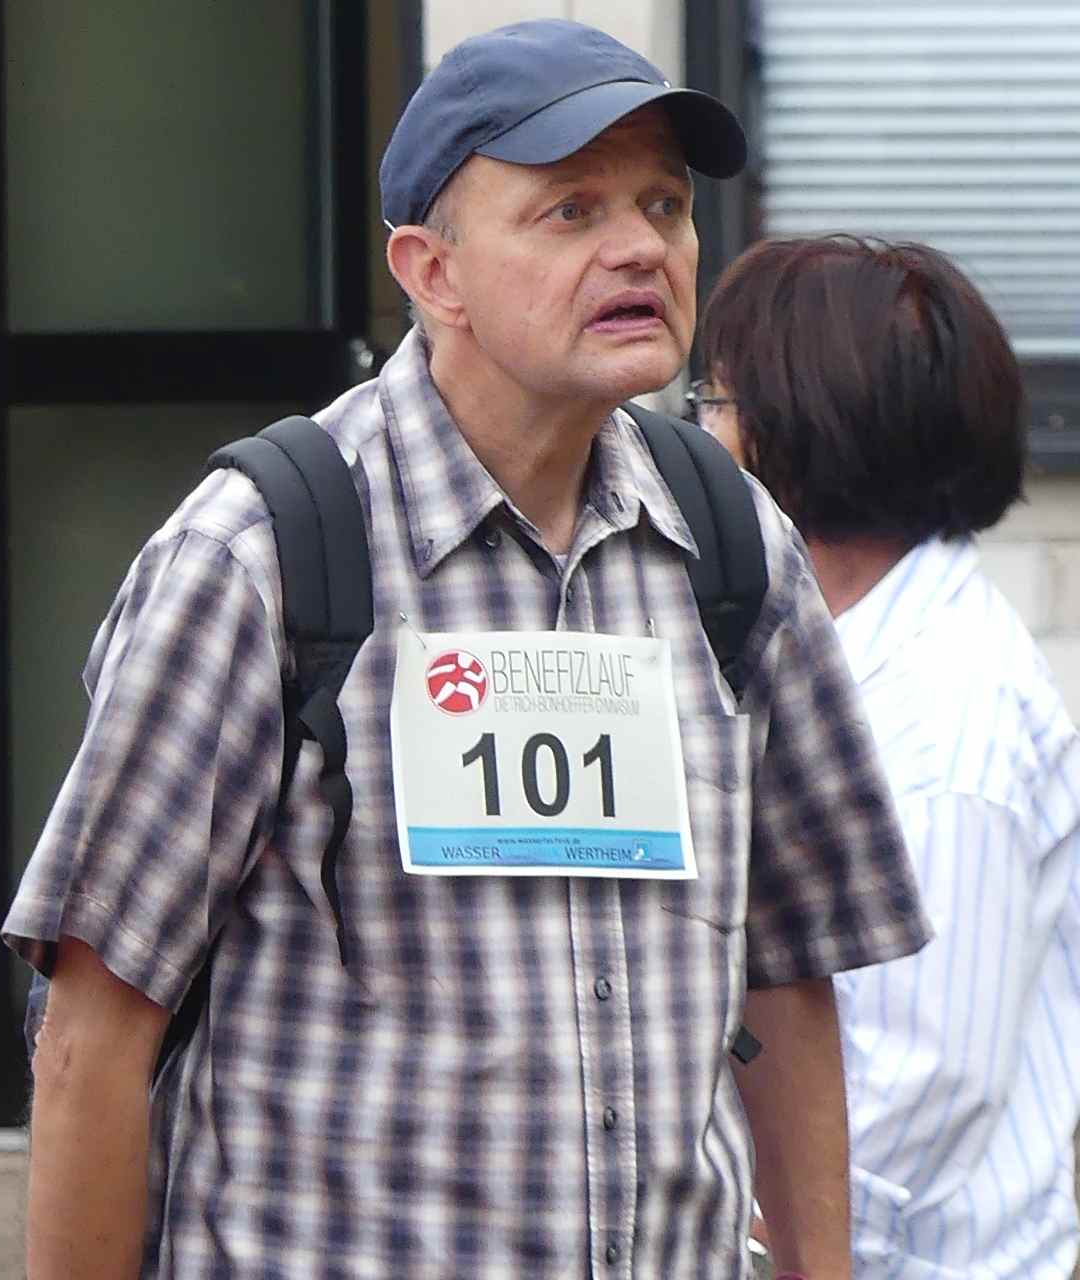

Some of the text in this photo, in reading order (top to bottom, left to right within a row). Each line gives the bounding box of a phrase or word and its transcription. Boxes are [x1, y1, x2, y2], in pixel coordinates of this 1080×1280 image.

[491, 651, 635, 697] BENEFIZLAUF
[461, 732, 616, 818] 101
[441, 846, 502, 860] WASSER
[565, 847, 632, 862] WERTHEIM
